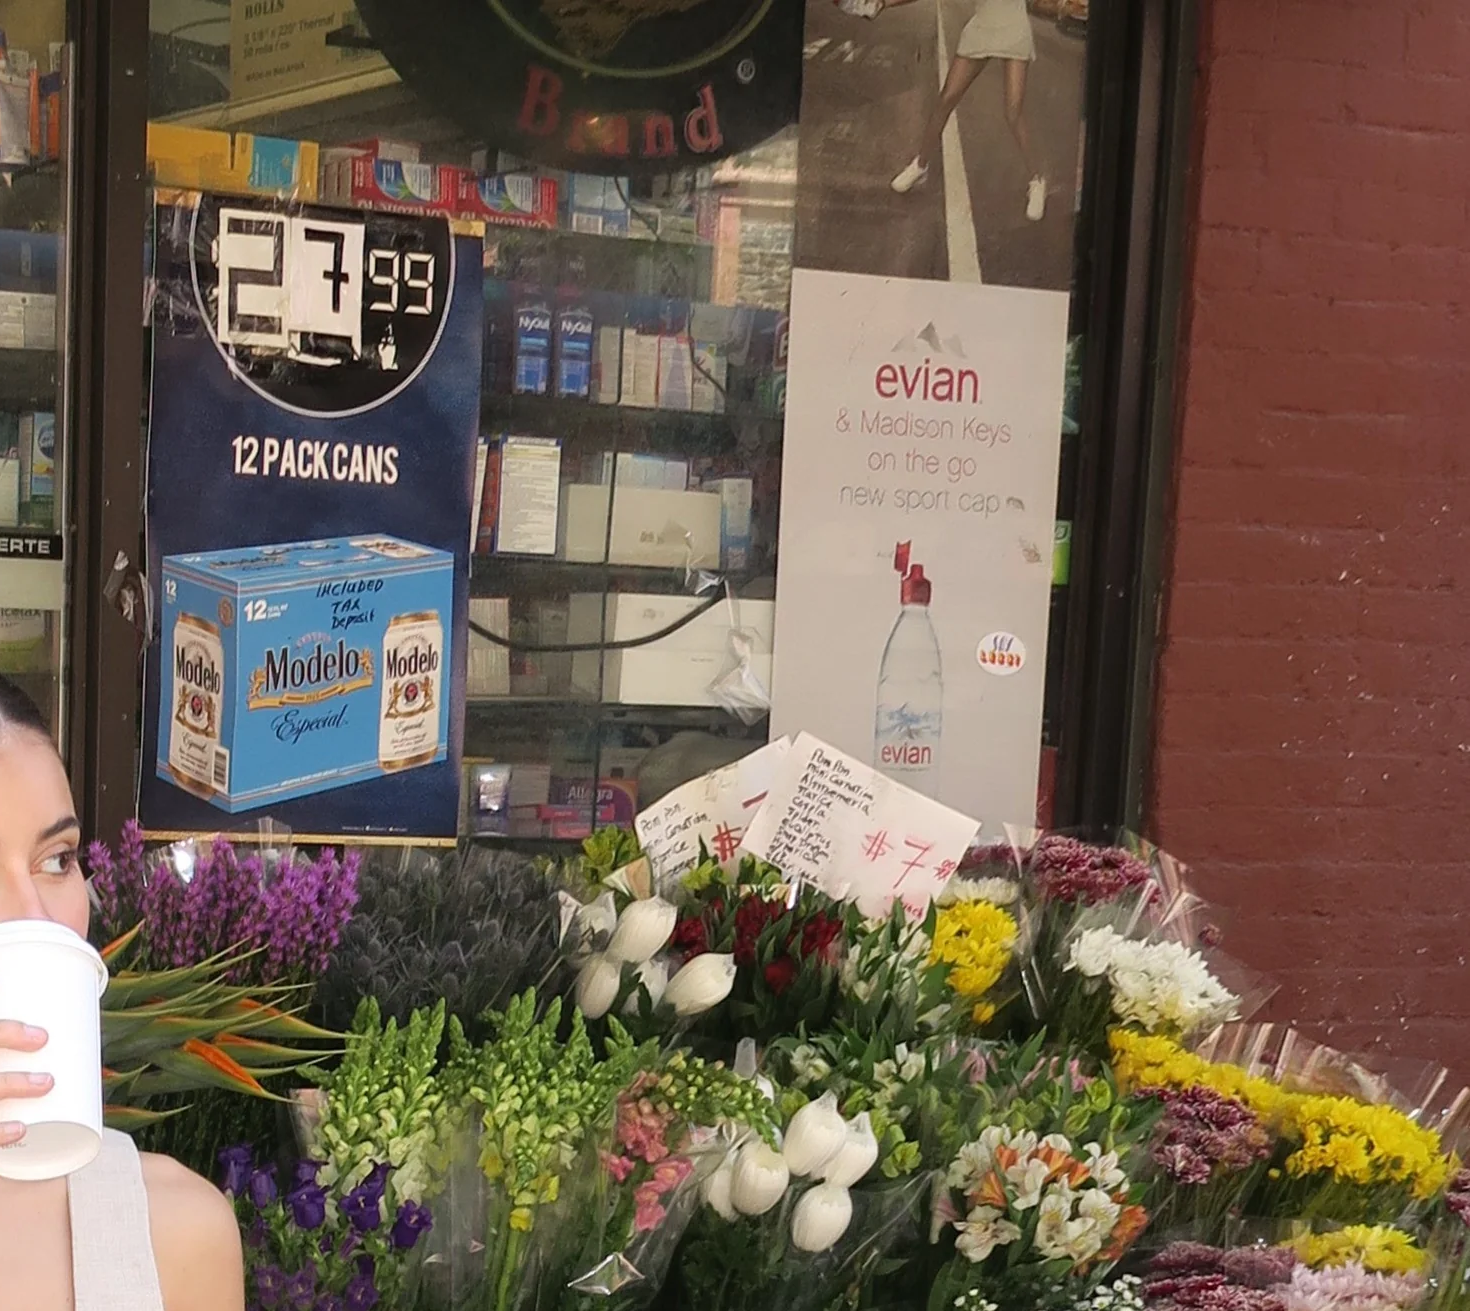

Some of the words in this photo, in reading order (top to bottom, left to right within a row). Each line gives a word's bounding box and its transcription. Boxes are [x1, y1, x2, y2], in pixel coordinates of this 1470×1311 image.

[516, 65, 724, 157] Brand
[875, 358, 979, 404] evian
[836, 407, 852, 433] &
[860, 410, 954, 440] Madison
[962, 416, 1012, 449] Keys
[232, 436, 258, 475] 12
[262, 437, 331, 480] PACK
[332, 442, 400, 485] CANS
[868, 452, 896, 471] on
[906, 449, 940, 475] the
[947, 456, 977, 483] go
[839, 486, 885, 507] new
[893, 488, 950, 515] sport
[958, 493, 1001, 519] cap
[164, 579, 177, 596] 12
[243, 599, 268, 623] 12
[175, 643, 222, 696] Modelo
[265, 637, 361, 694] Modelo
[386, 642, 439, 681] Modelo
[270, 702, 350, 746] Especial
[881, 743, 932, 765] evian
